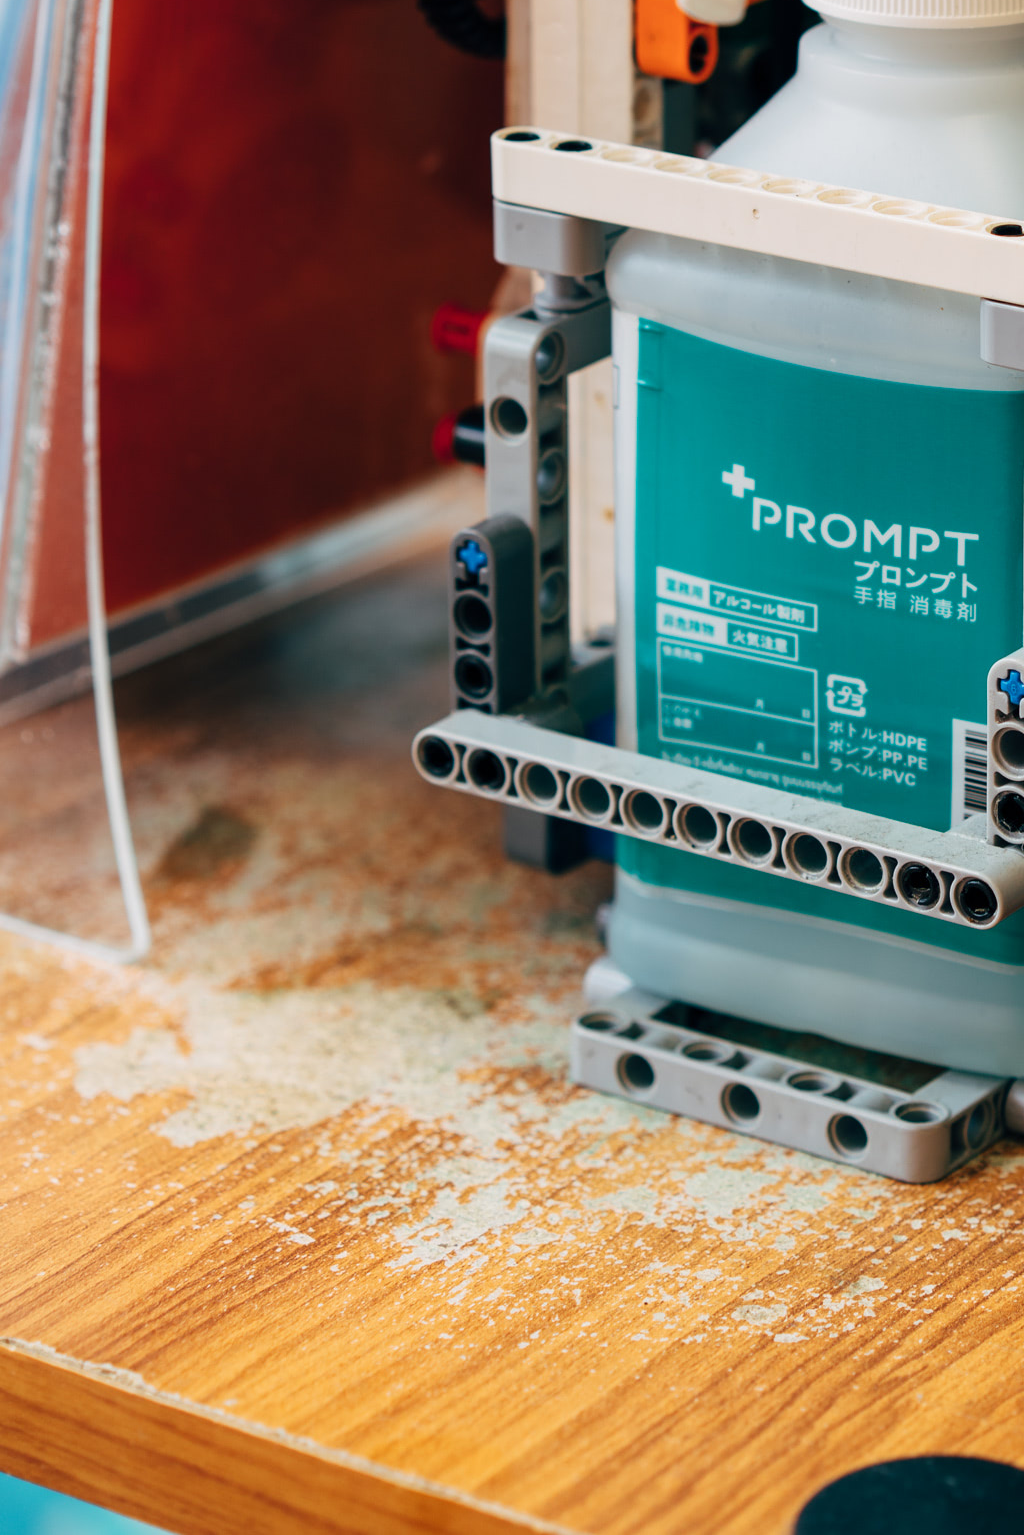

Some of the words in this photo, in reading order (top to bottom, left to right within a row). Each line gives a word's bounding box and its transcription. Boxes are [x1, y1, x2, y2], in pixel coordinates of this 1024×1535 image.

[752, 496, 979, 567] PROMPT
[854, 560, 978, 599] プロンプト
[854, 585, 897, 610] 手指
[909, 594, 977, 623] 消毒剤
